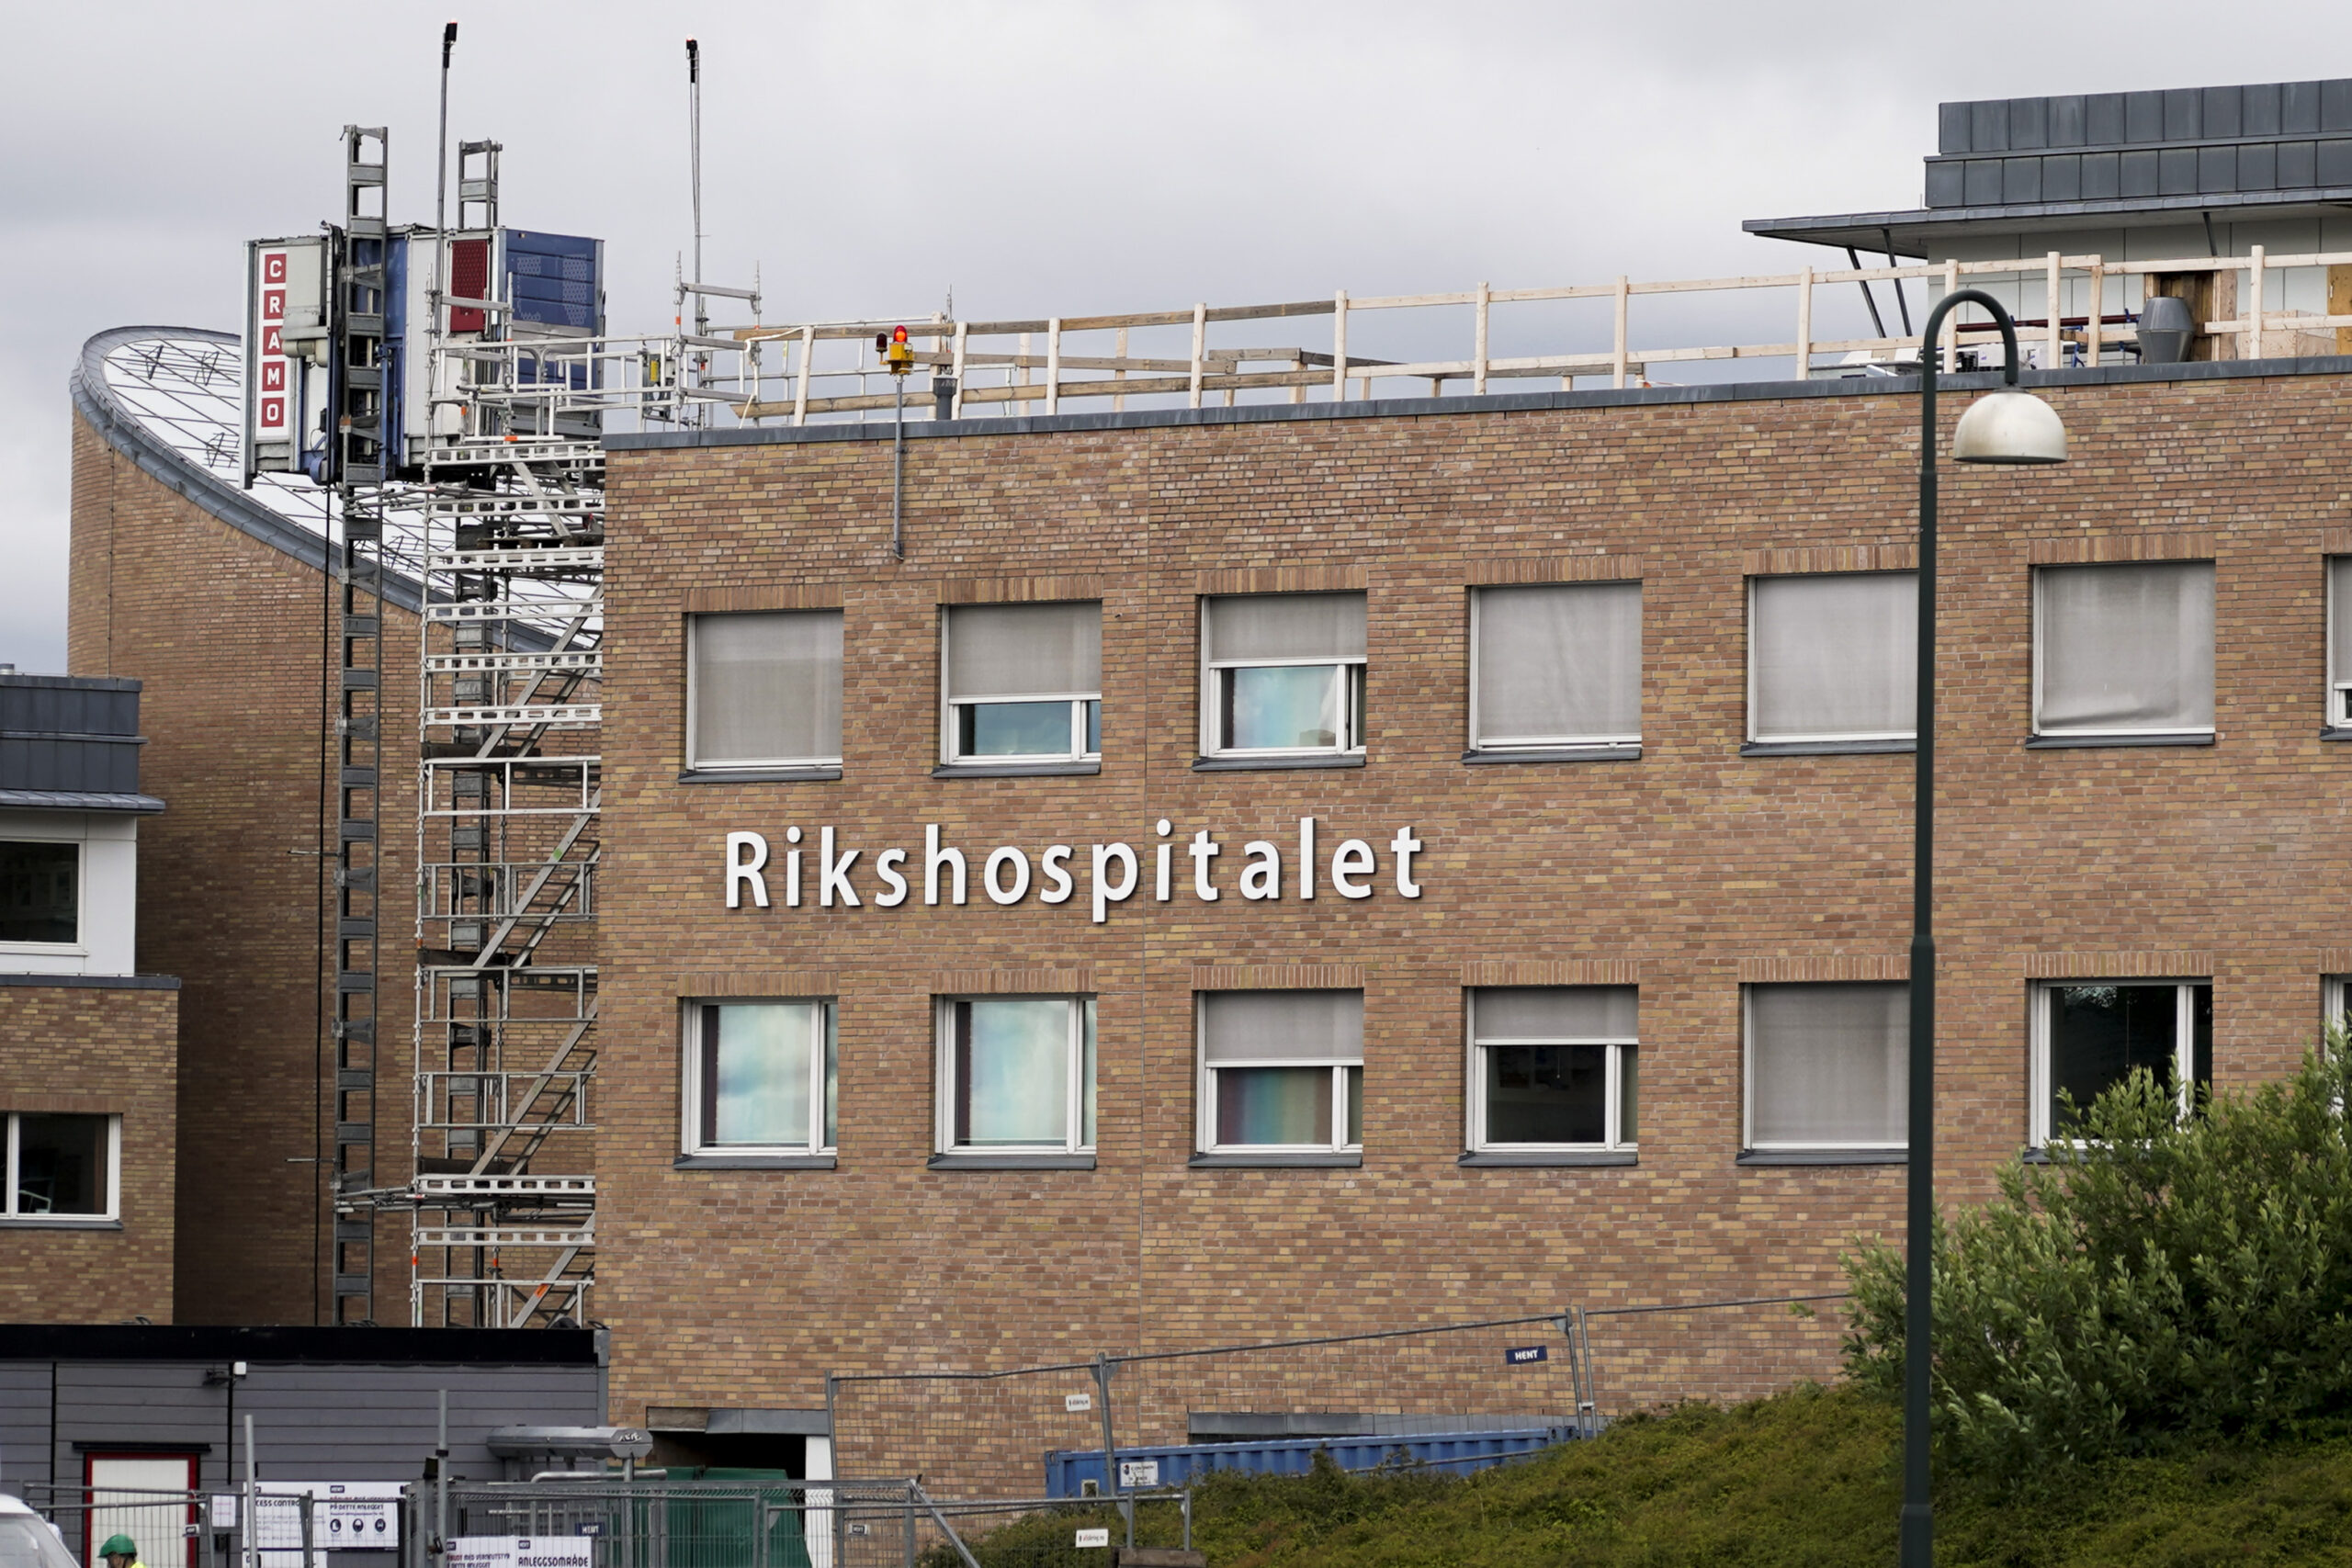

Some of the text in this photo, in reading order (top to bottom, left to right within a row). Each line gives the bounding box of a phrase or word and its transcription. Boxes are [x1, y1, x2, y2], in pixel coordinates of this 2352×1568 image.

[266, 259, 283, 422] CRAMO
[726, 817, 1422, 922] Rikshospitalet
[1514, 1349, 1538, 1360] HENT
[273, 1499, 301, 1507] CONTRO
[582, 1525, 600, 1534] HENT
[518, 1553, 589, 1567] ANLEGGSOMRÅDE
